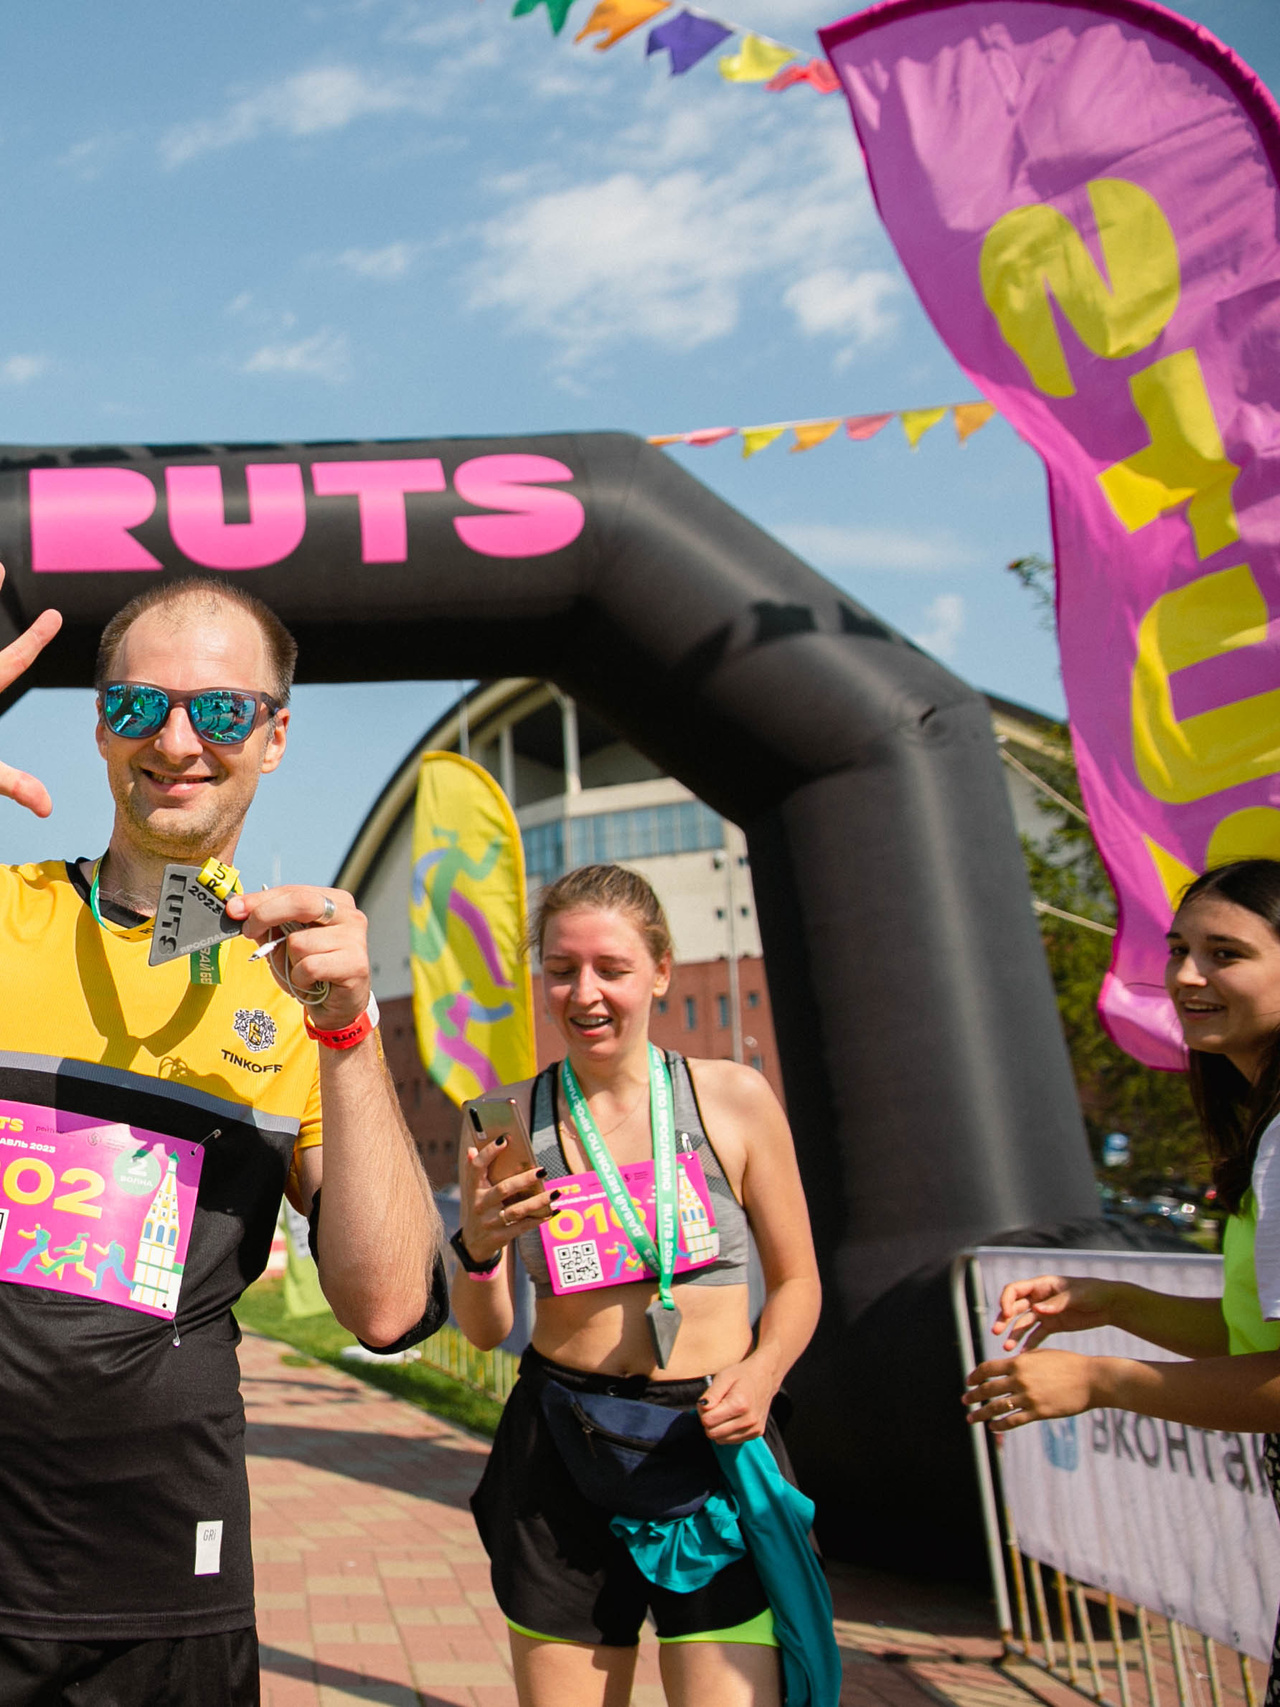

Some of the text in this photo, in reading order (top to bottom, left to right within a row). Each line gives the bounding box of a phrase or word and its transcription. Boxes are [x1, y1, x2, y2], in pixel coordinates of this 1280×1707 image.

[29, 453, 585, 573] RUTS
[188, 885, 223, 915] 2023
[159, 873, 187, 955] RUTS
[199, 947, 215, 971] ВАЙ
[221, 1049, 283, 1074] TINKOFF
[29, 1141, 56, 1154] 2023
[587, 1132, 603, 1152] ПО
[127, 1157, 148, 1177] 2
[595, 1151, 622, 1195] БЕГОМ
[120, 1174, 153, 1188] ВОЛНА
[614, 1194, 645, 1238] ДАВАЙ
[663, 1203, 675, 1239] RUTS
